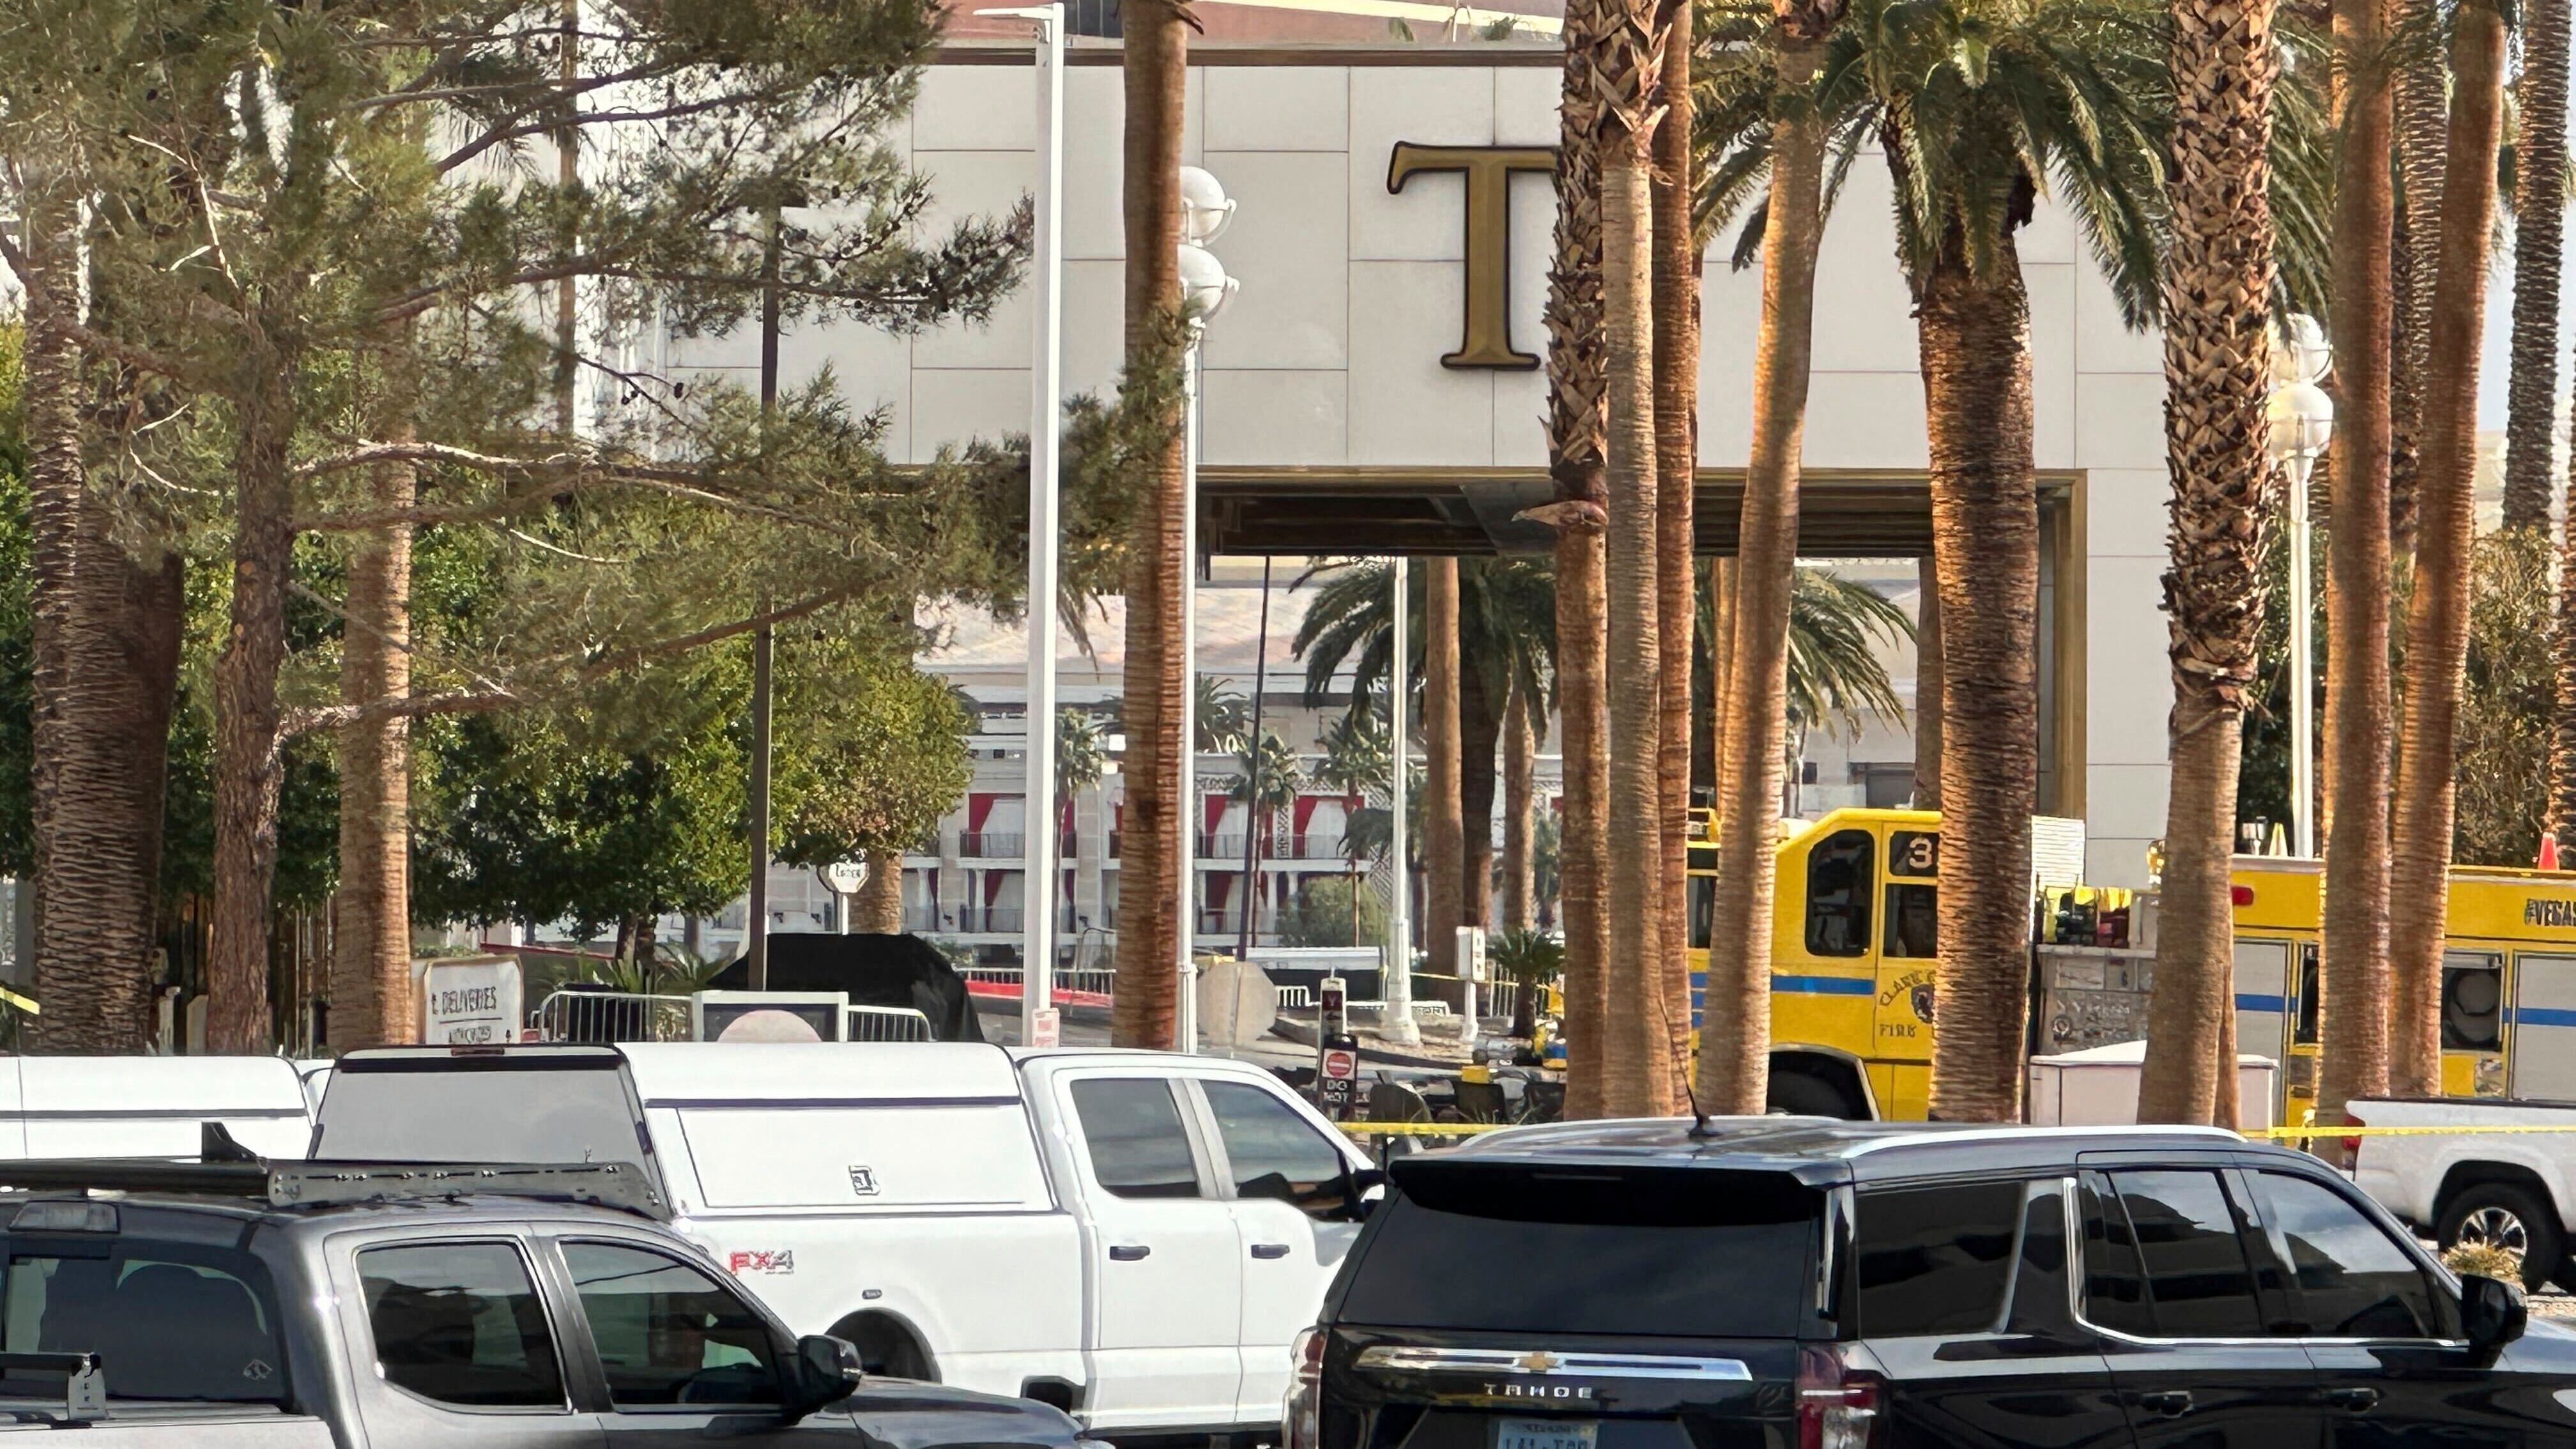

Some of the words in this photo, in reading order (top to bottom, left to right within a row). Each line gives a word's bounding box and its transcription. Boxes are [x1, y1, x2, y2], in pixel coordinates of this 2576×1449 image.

[1386, 141, 1559, 370] T
[1909, 836, 1933, 870] 3
[730, 1249, 793, 1275] FX4
[1484, 1383, 1593, 1399] TAHOE
